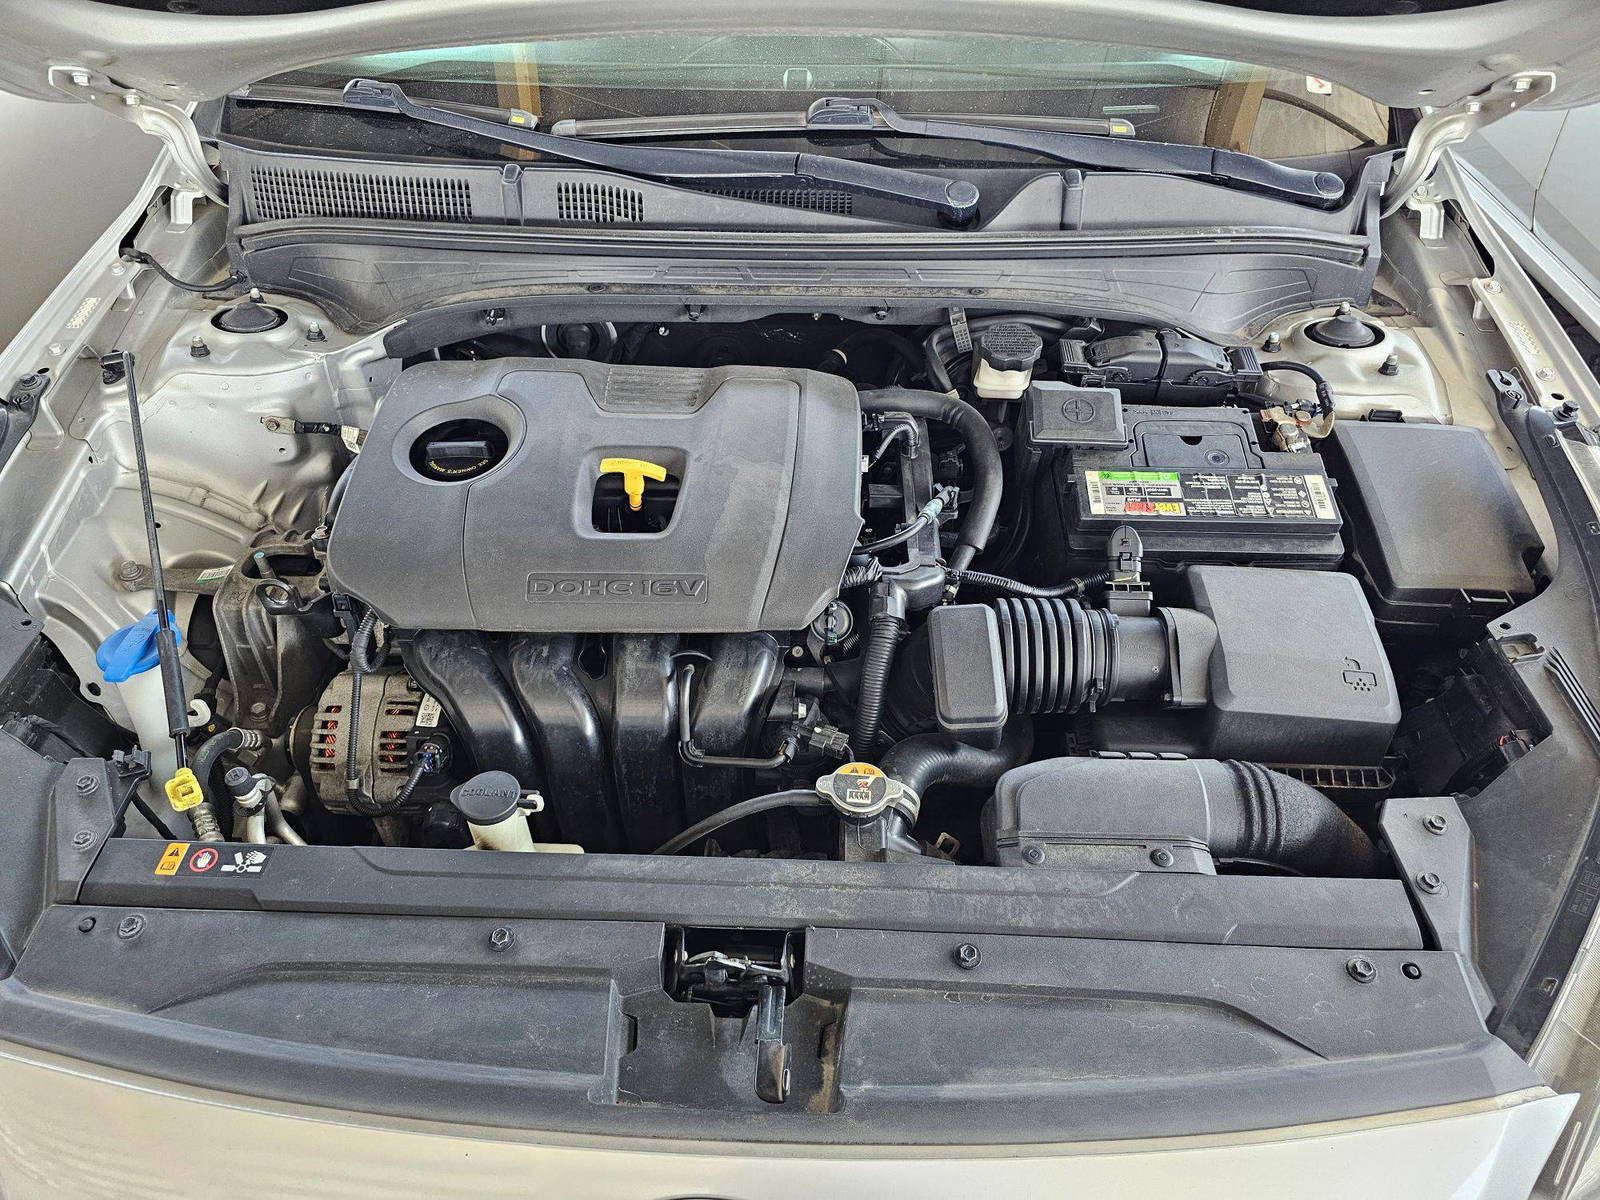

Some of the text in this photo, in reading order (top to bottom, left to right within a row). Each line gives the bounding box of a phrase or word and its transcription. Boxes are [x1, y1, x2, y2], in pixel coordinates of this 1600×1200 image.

[447, 465, 477, 474] OWNER'S
[529, 579, 705, 597] DOHC 16V
[460, 787, 518, 799] COOLANT
